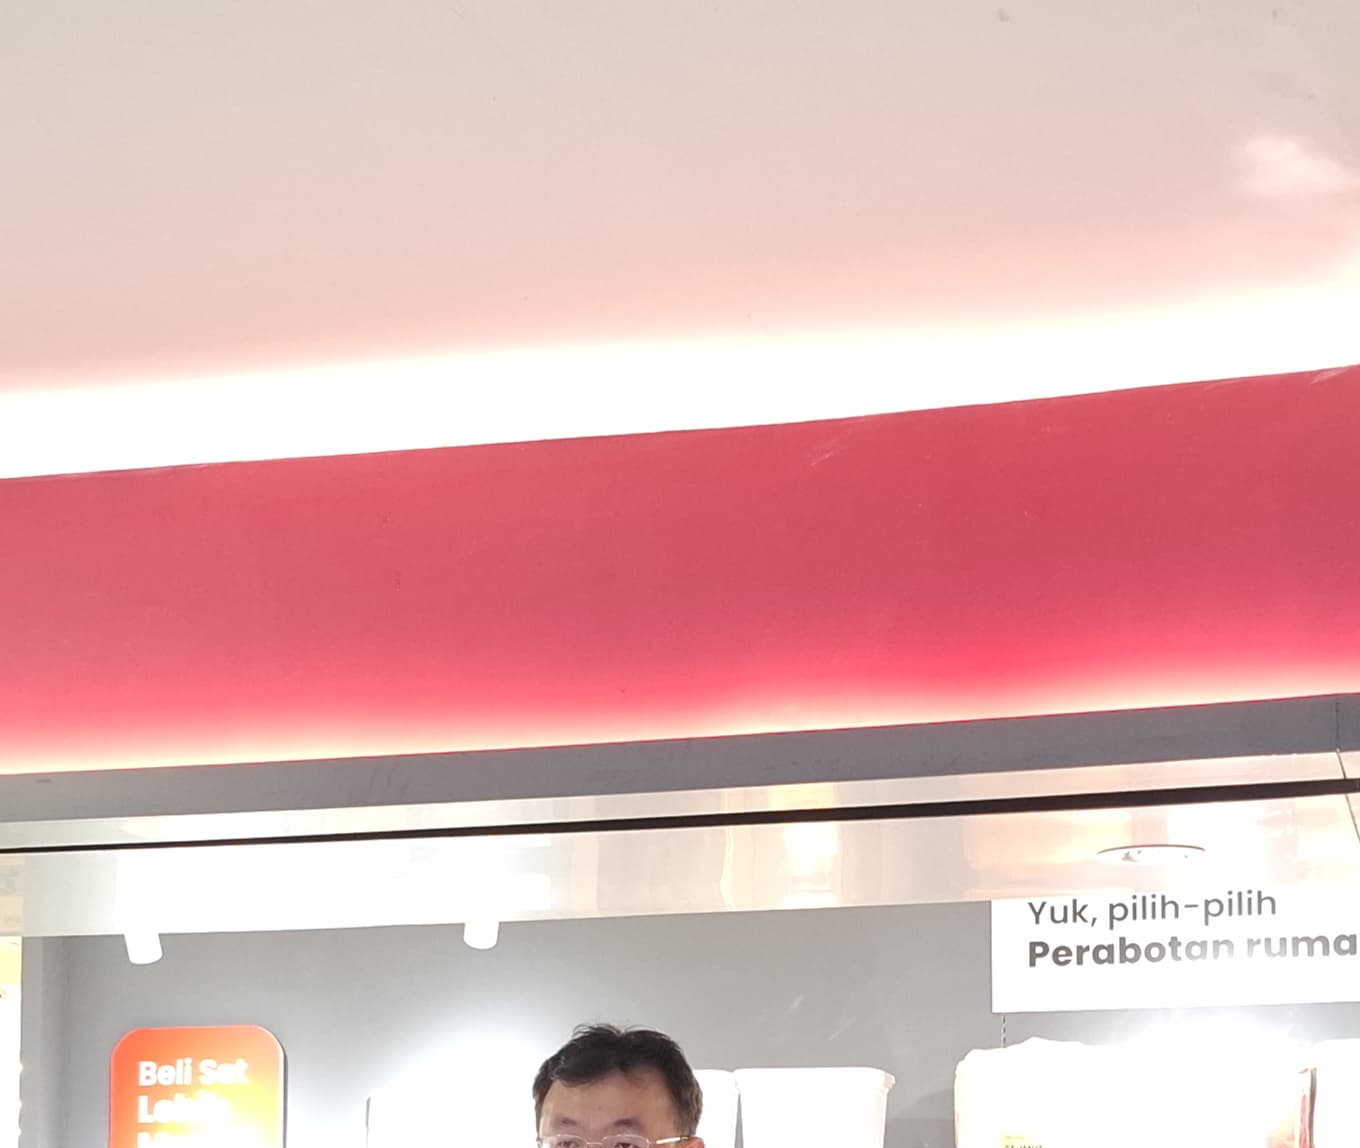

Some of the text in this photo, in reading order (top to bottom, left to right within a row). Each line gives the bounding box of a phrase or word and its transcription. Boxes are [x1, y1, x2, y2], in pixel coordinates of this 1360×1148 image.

[1028, 890, 1277, 930] Yuk, pilih-pilih
[1029, 936, 1235, 968] Perabotan
[138, 1057, 192, 1086] Beli
